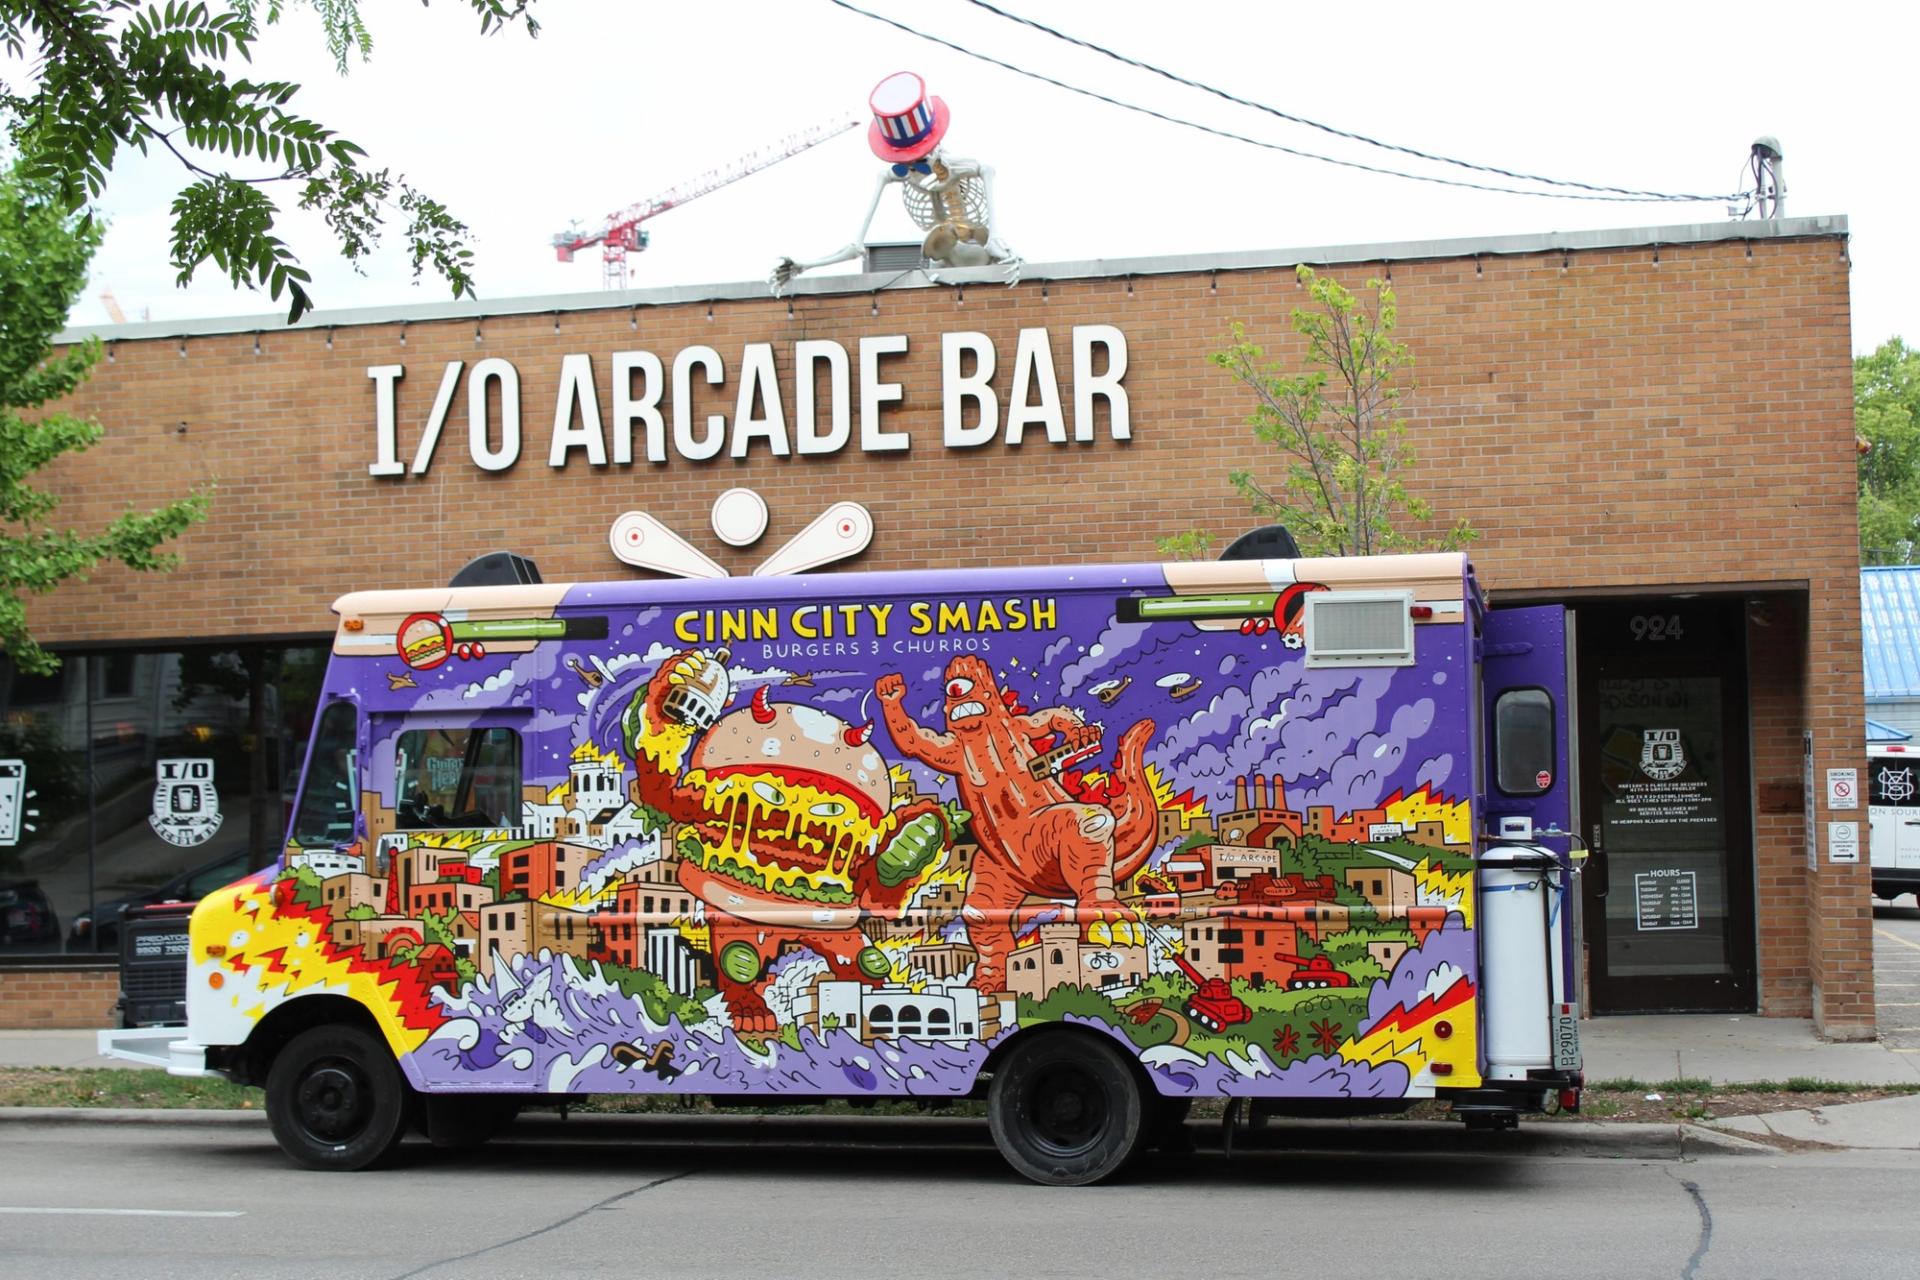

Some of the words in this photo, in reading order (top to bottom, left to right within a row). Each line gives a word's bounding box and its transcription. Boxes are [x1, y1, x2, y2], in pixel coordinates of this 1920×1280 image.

[367, 358, 521, 476] I/O
[549, 335, 910, 467] ARCADE
[941, 325, 1132, 448] BAR
[674, 608, 779, 642] CINN
[790, 604, 893, 639] CITY
[909, 599, 1057, 635] SMASH
[1630, 615, 1683, 640] 924
[763, 642, 859, 659] BURGERS
[893, 638, 991, 653] CHURROS
[1646, 731, 1677, 741] I/O
[161, 763, 209, 779] I/O
[1891, 808, 1920, 816] SOUR
[1240, 855, 1277, 864] ARCADE
[1650, 869, 1680, 877] HOURS
